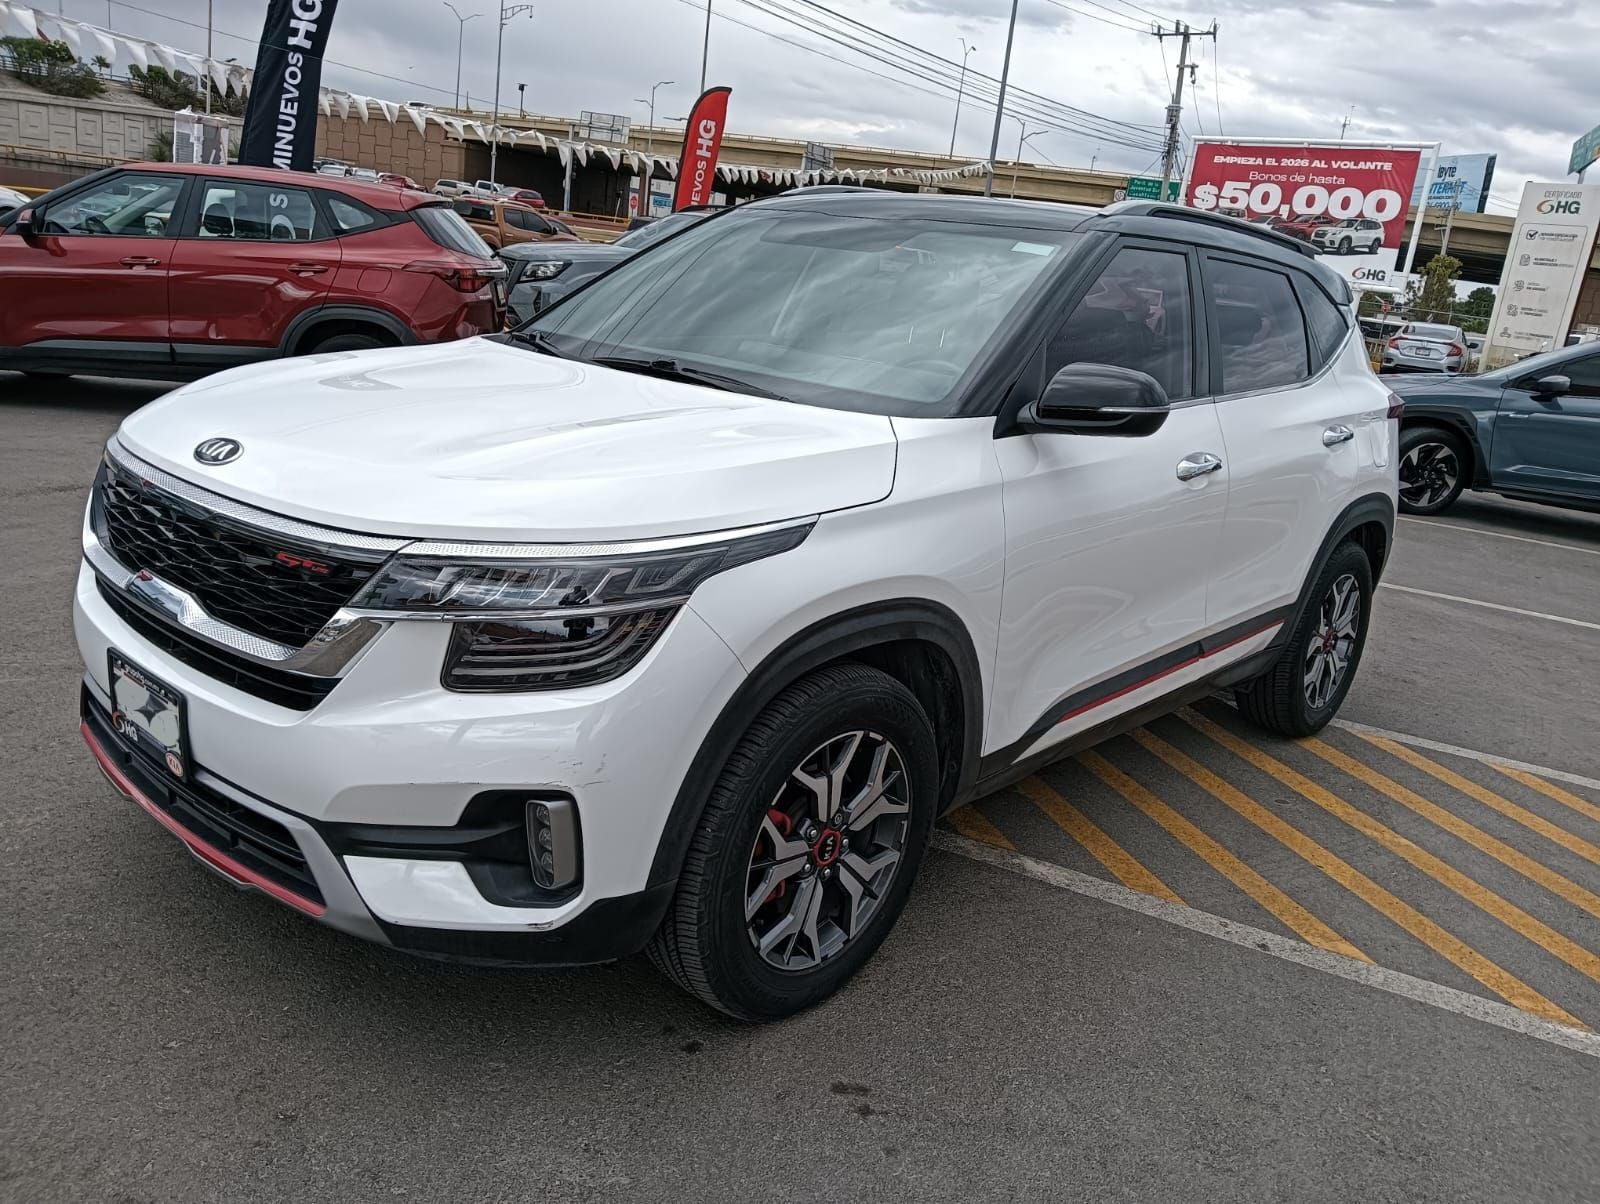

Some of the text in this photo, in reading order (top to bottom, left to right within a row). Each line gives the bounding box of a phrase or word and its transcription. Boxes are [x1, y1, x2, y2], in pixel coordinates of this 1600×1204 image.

[696, 119, 716, 158] HG
[1213, 155, 1393, 171] EMPIEZA EL 2026 AL VOLANTE
[1249, 171, 1346, 185] Bonos de hasta
[1192, 180, 1402, 222] $50,000
[1543, 190, 1583, 199] CERTIFICADO
[1555, 200, 1581, 214] HG
[1366, 268, 1386, 281] HG
[200, 439, 235, 460] KIA
